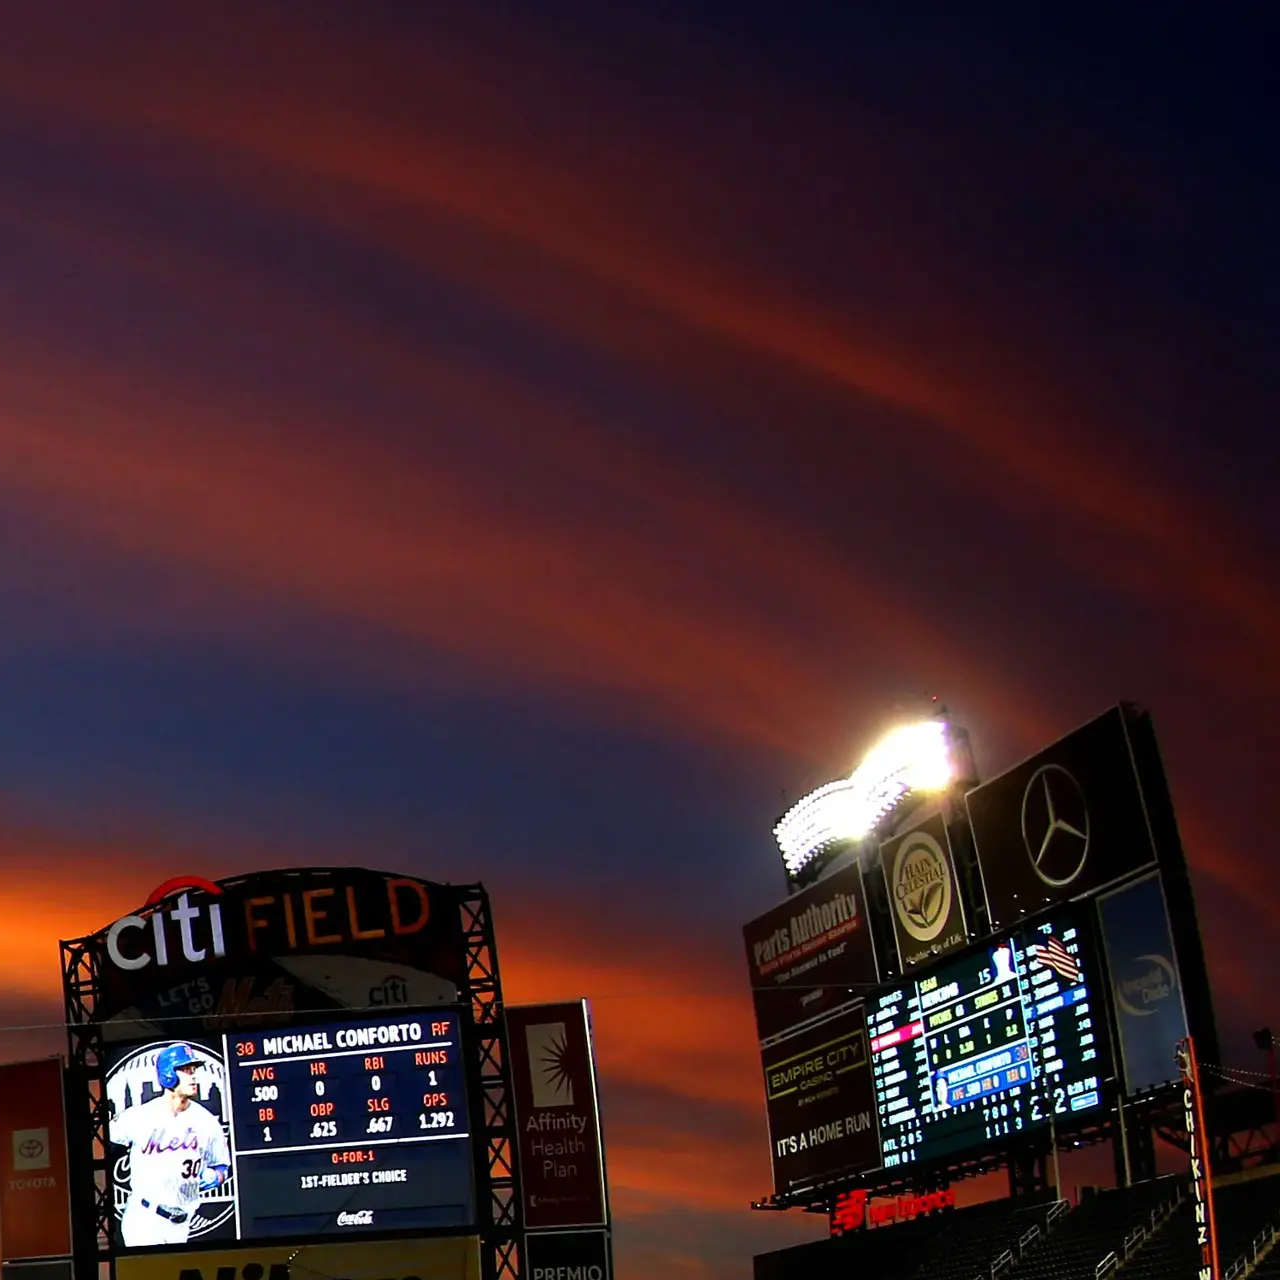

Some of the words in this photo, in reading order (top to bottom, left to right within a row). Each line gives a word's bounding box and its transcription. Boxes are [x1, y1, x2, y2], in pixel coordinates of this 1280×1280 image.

[897, 863, 944, 900] CELESTIAL
[904, 858, 931, 880] HAIN
[106, 891, 226, 970] citi
[242, 878, 431, 953] FIELD
[753, 927, 791, 967] Parts
[790, 893, 857, 946] Authority
[978, 968, 991, 985] 15
[156, 976, 210, 1008] LET'S
[189, 994, 214, 1013] GO
[203, 975, 295, 1030] Mets
[369, 977, 407, 1005] citi
[236, 1042, 255, 1056] 30
[263, 1033, 332, 1055] MICHAEL
[336, 1023, 421, 1047] CONFORTO
[431, 1021, 450, 1036] RF
[252, 1067, 274, 1081] AVG
[310, 1063, 327, 1075] HR
[364, 1056, 384, 1070] RBI
[415, 1050, 447, 1066] RUNS
[770, 1056, 824, 1088] EMPIRE
[827, 1041, 860, 1066] CITY
[251, 1085, 278, 1102] .500
[315, 1080, 325, 1096] 0
[371, 1075, 381, 1091] 0
[428, 1071, 437, 1086] 1
[800, 1071, 834, 1091] CASINO
[1084, 1076, 1097, 1090] PM
[258, 1108, 274, 1121] BB
[310, 1102, 333, 1117] OBP
[367, 1097, 389, 1112] SLG
[423, 1093, 447, 1107] OPS
[263, 1127, 272, 1142] 1
[310, 1121, 337, 1138] .625
[366, 1117, 393, 1133] .667
[419, 1111, 454, 1129] 1.292
[526, 1113, 587, 1134] Affinity
[776, 1135, 798, 1158] IT'S
[800, 1132, 808, 1151] A
[808, 1120, 845, 1149] HOME
[845, 1110, 871, 1136] RUN
[142, 1127, 198, 1155] Mets
[531, 1134, 586, 1156] Health
[883, 1139, 899, 1153] ATL
[181, 1158, 201, 1179] 30
[332, 1151, 375, 1164] 0-FOR-1
[543, 1160, 578, 1179] Plan
[884, 1154, 900, 1168] NYM
[1184, 1089, 1208, 1244] CHIKINZ
[8, 1176, 57, 1191] TOYOTA
[301, 1171, 369, 1189] 1ST-FIELDER'S
[372, 1169, 407, 1184] CHOICE
[898, 1189, 956, 1217] balance
